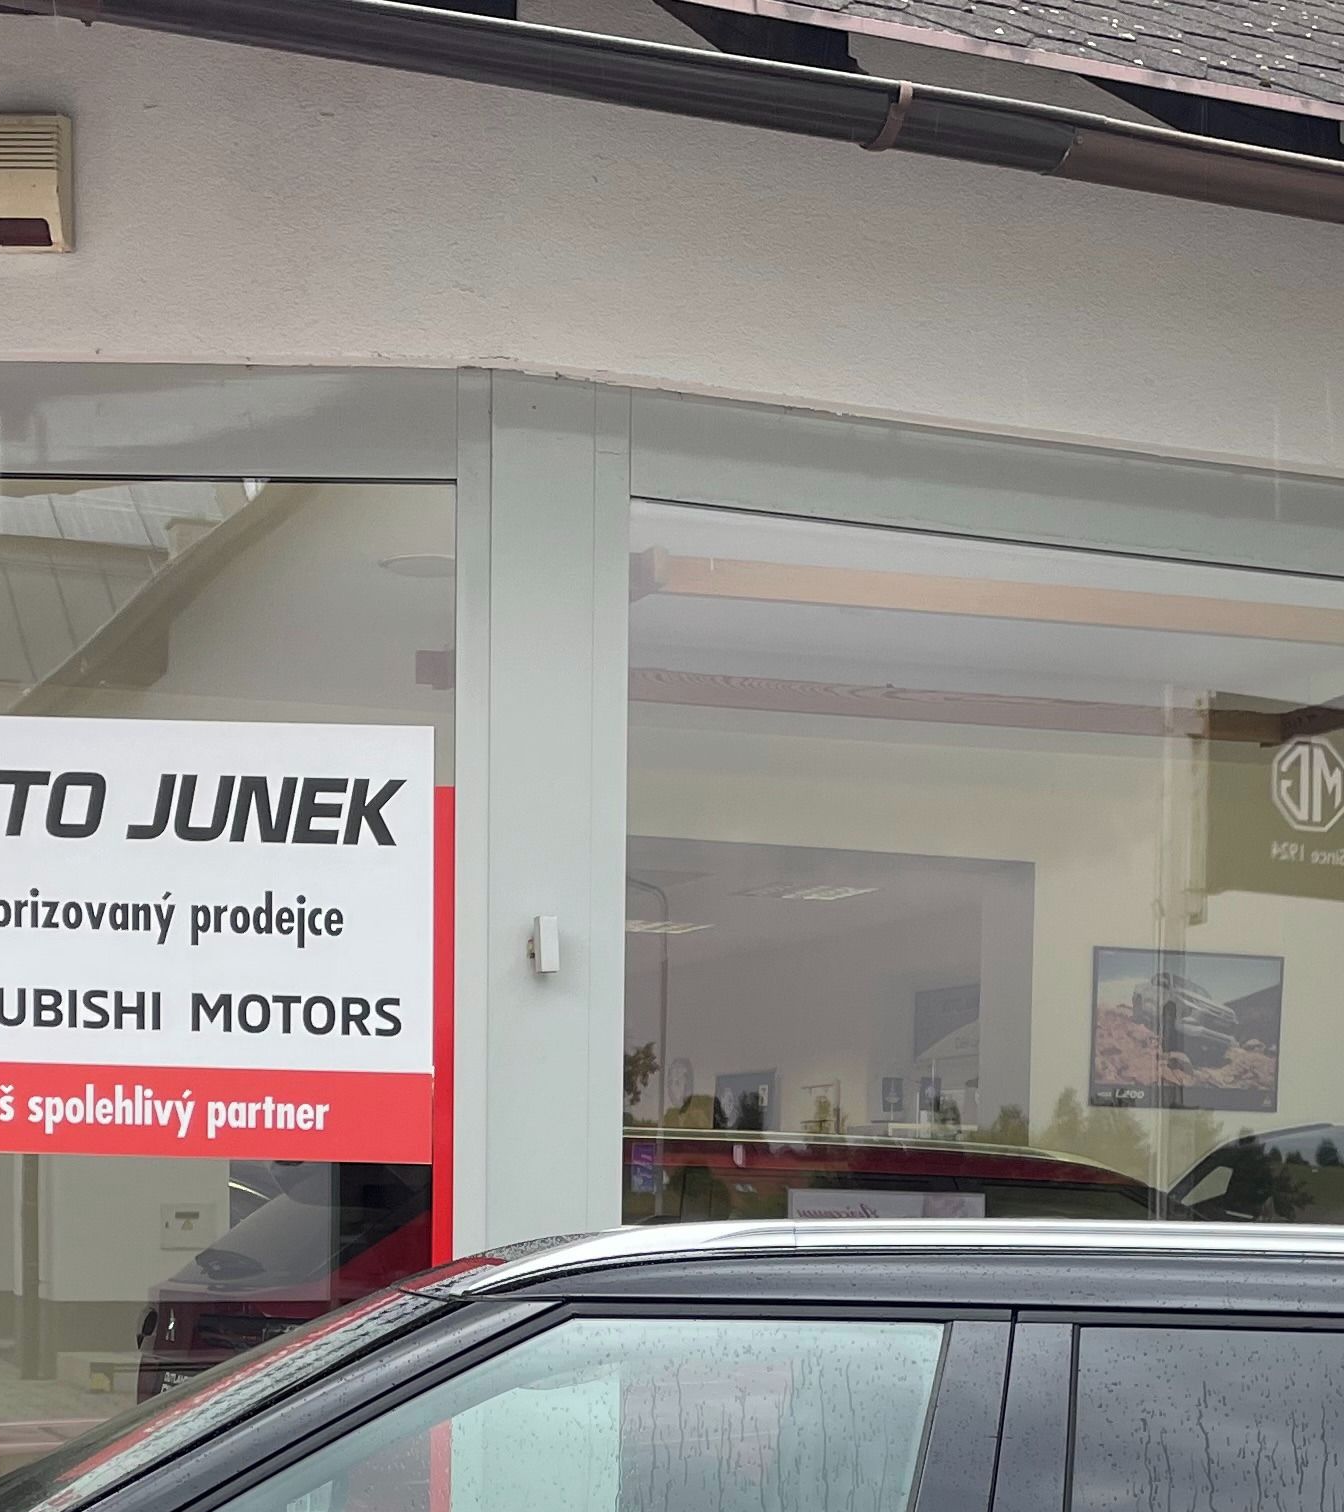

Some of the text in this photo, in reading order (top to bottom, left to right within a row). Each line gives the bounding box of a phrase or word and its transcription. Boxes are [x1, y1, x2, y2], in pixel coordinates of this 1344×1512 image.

[125, 773, 408, 847] JUNEK
[190, 890, 344, 949] prodejce
[191, 992, 402, 1037] MOTORS
[27, 1083, 196, 1138] spolehlivý
[207, 1096, 330, 1139] partner
